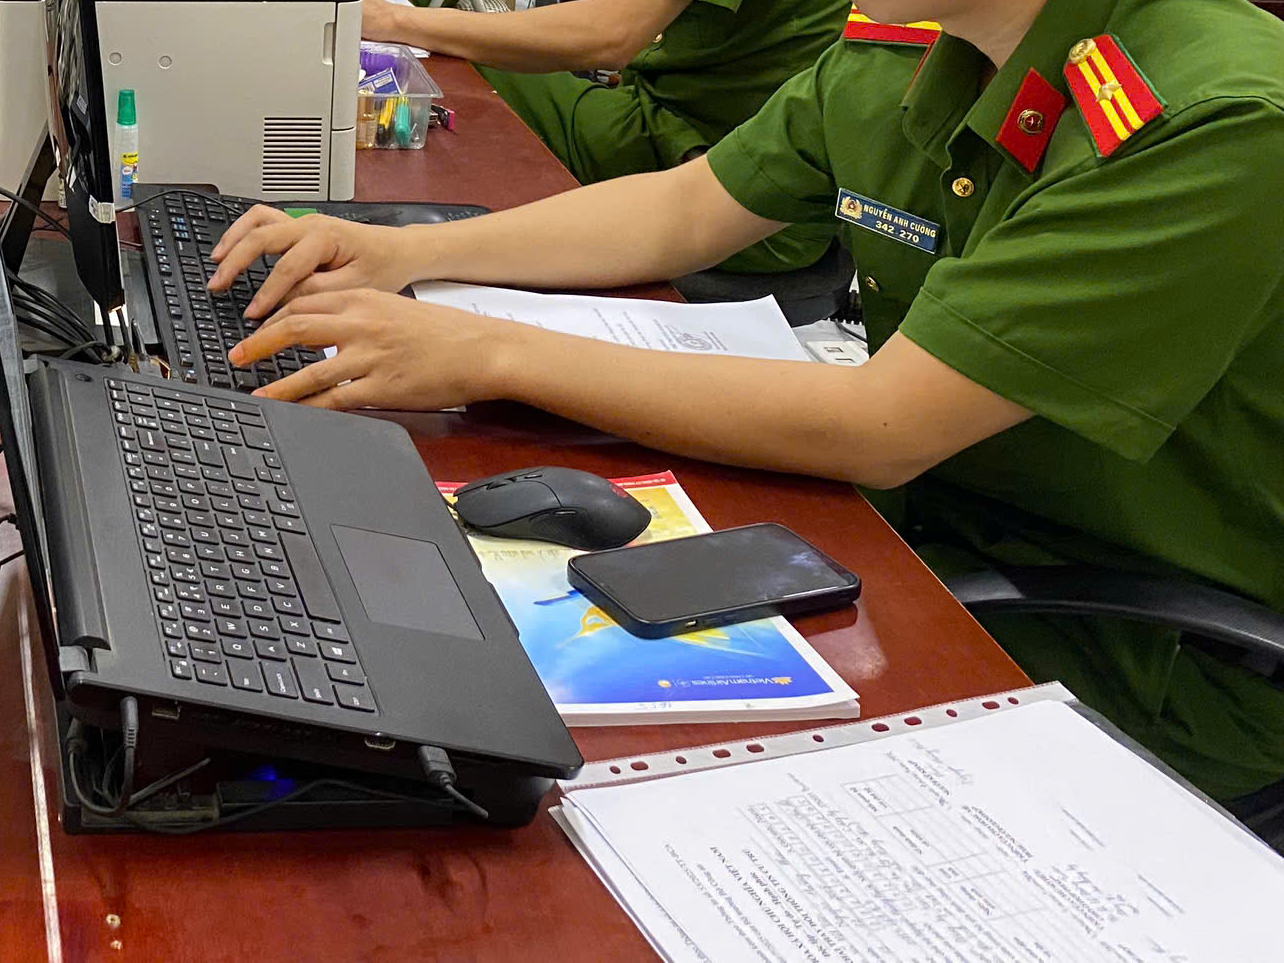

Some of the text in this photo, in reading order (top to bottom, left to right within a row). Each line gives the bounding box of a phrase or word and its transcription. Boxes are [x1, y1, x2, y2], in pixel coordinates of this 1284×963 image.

[863, 204, 893, 221] NGUYỄN
[893, 216, 909, 227] ANH
[875, 220, 920, 243] 342 270
[226, 621, 236, 630] W
[231, 642, 242, 650] Q
[729, 677, 774, 685] Vietnam
